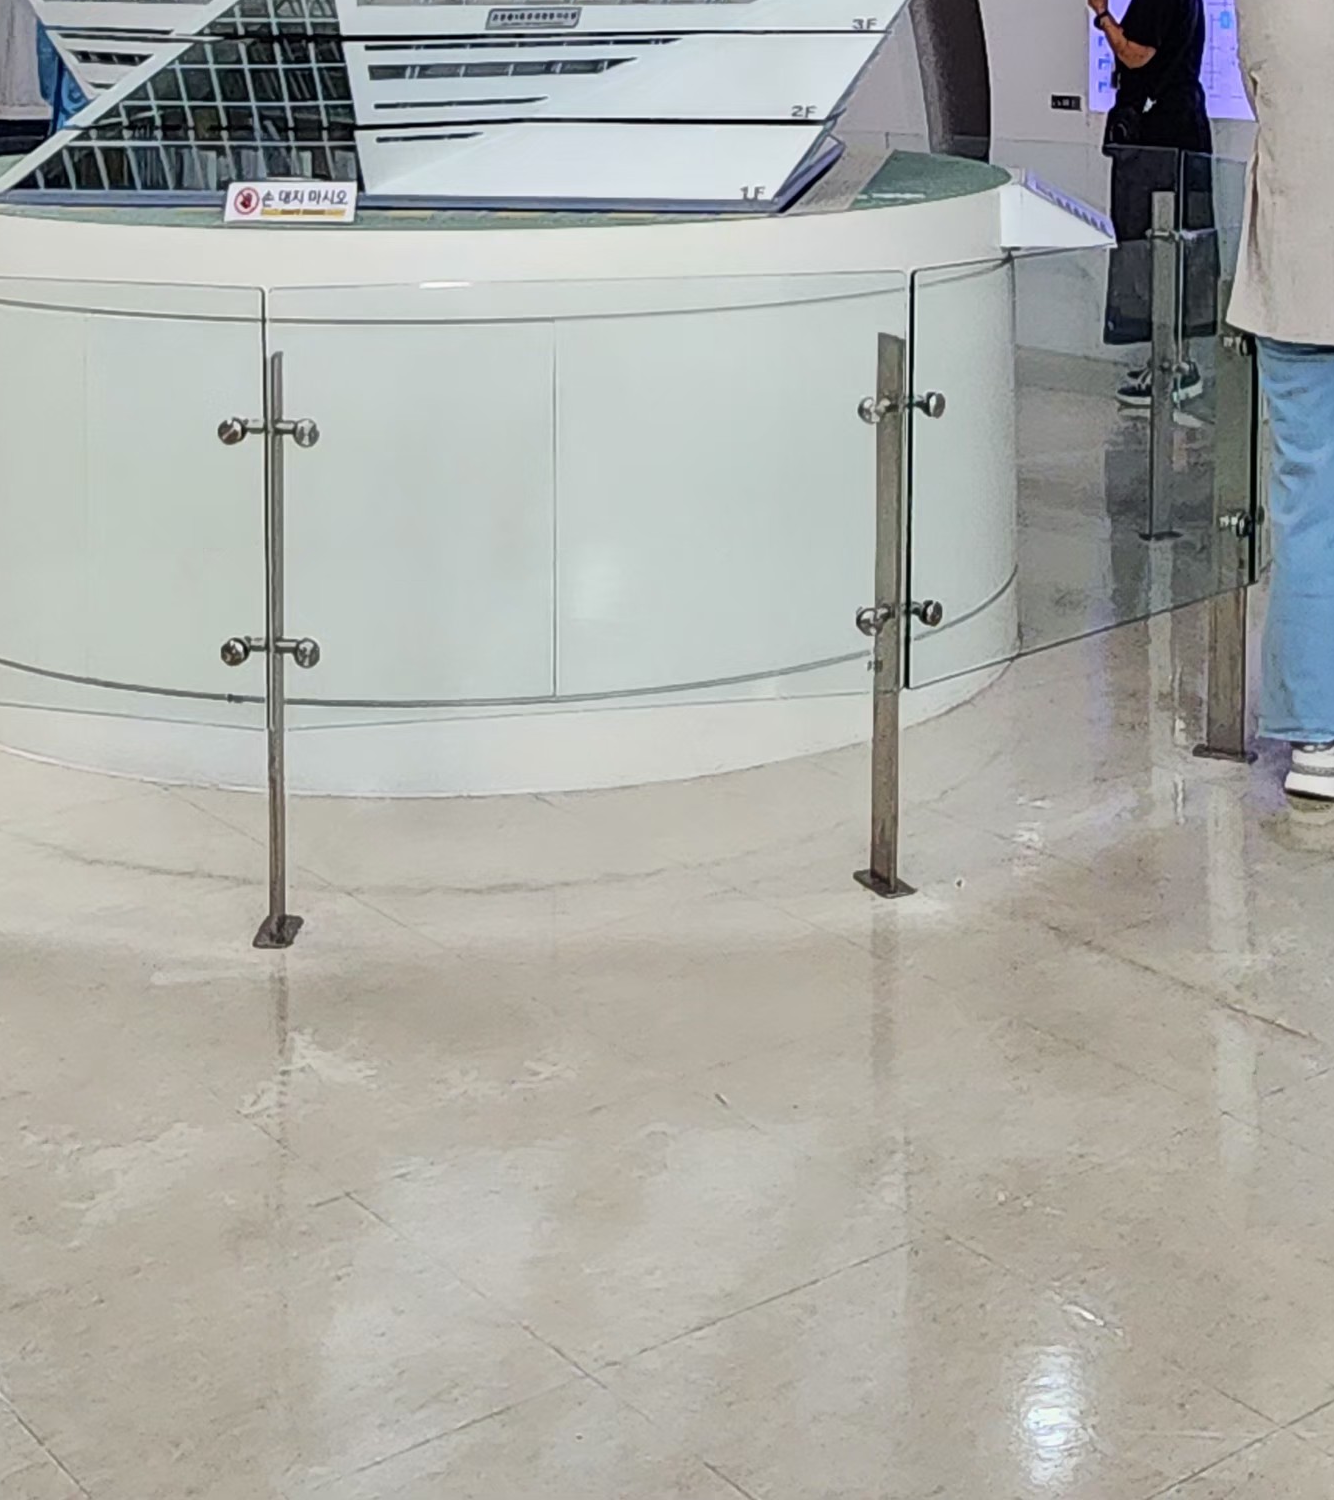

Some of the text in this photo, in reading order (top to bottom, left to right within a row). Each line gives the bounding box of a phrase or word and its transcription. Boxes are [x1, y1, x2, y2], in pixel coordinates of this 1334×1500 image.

[852, 18, 877, 30] 3F
[791, 105, 817, 118] 2F
[262, 189, 349, 207] 손 대지 마시오
[740, 186, 766, 200] 1F
